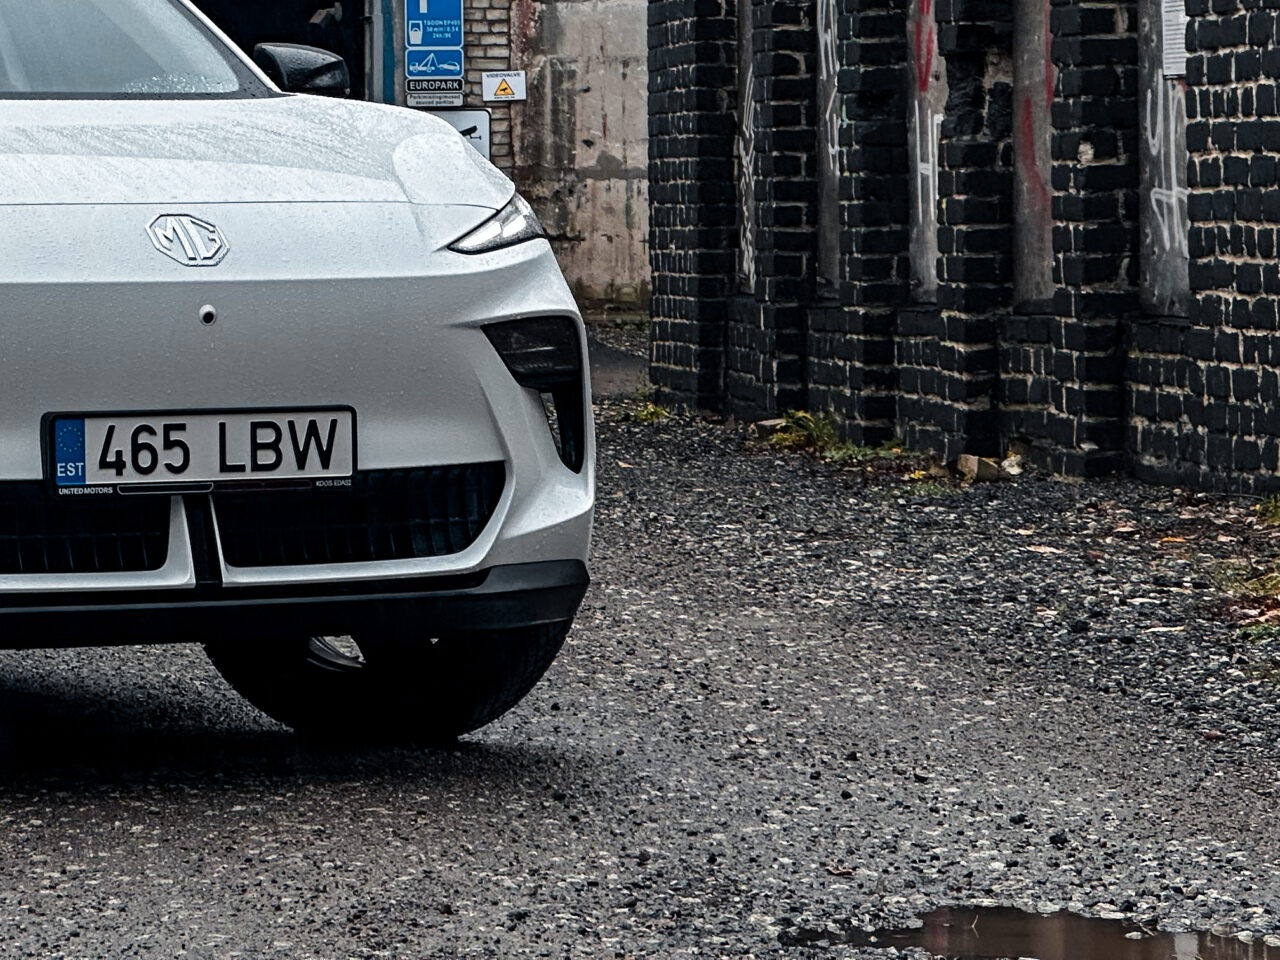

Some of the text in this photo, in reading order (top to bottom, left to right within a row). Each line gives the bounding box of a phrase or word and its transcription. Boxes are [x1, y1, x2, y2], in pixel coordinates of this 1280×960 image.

[410, 81, 459, 90] EUROPARK
[148, 214, 228, 265] MG
[98, 419, 338, 477] 465 LBW
[57, 462, 85, 477] EST
